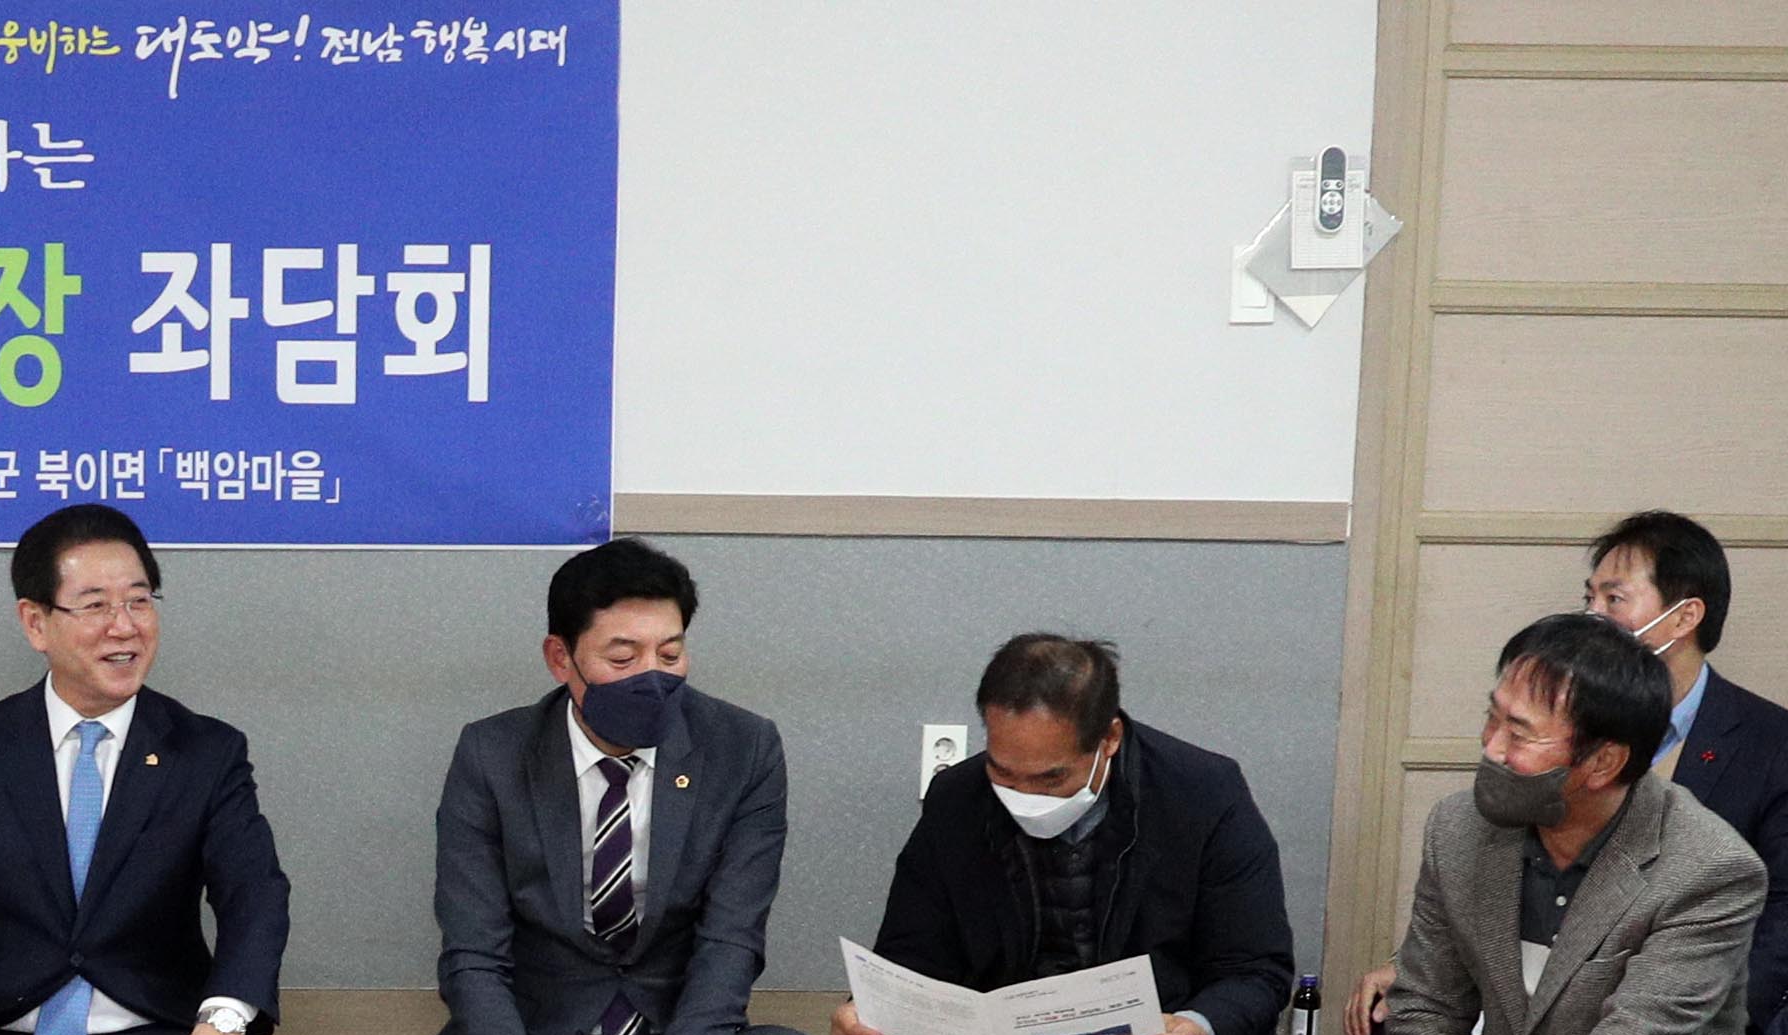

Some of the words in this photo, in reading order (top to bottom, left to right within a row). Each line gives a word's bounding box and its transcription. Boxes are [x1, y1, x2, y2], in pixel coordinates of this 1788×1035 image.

[134, 14, 311, 100] 대도약!
[320, 22, 405, 66] 전남
[128, 242, 491, 405] 좌담회
[35, 449, 145, 500] 북이면
[158, 447, 340, 504] 「백암마을」
